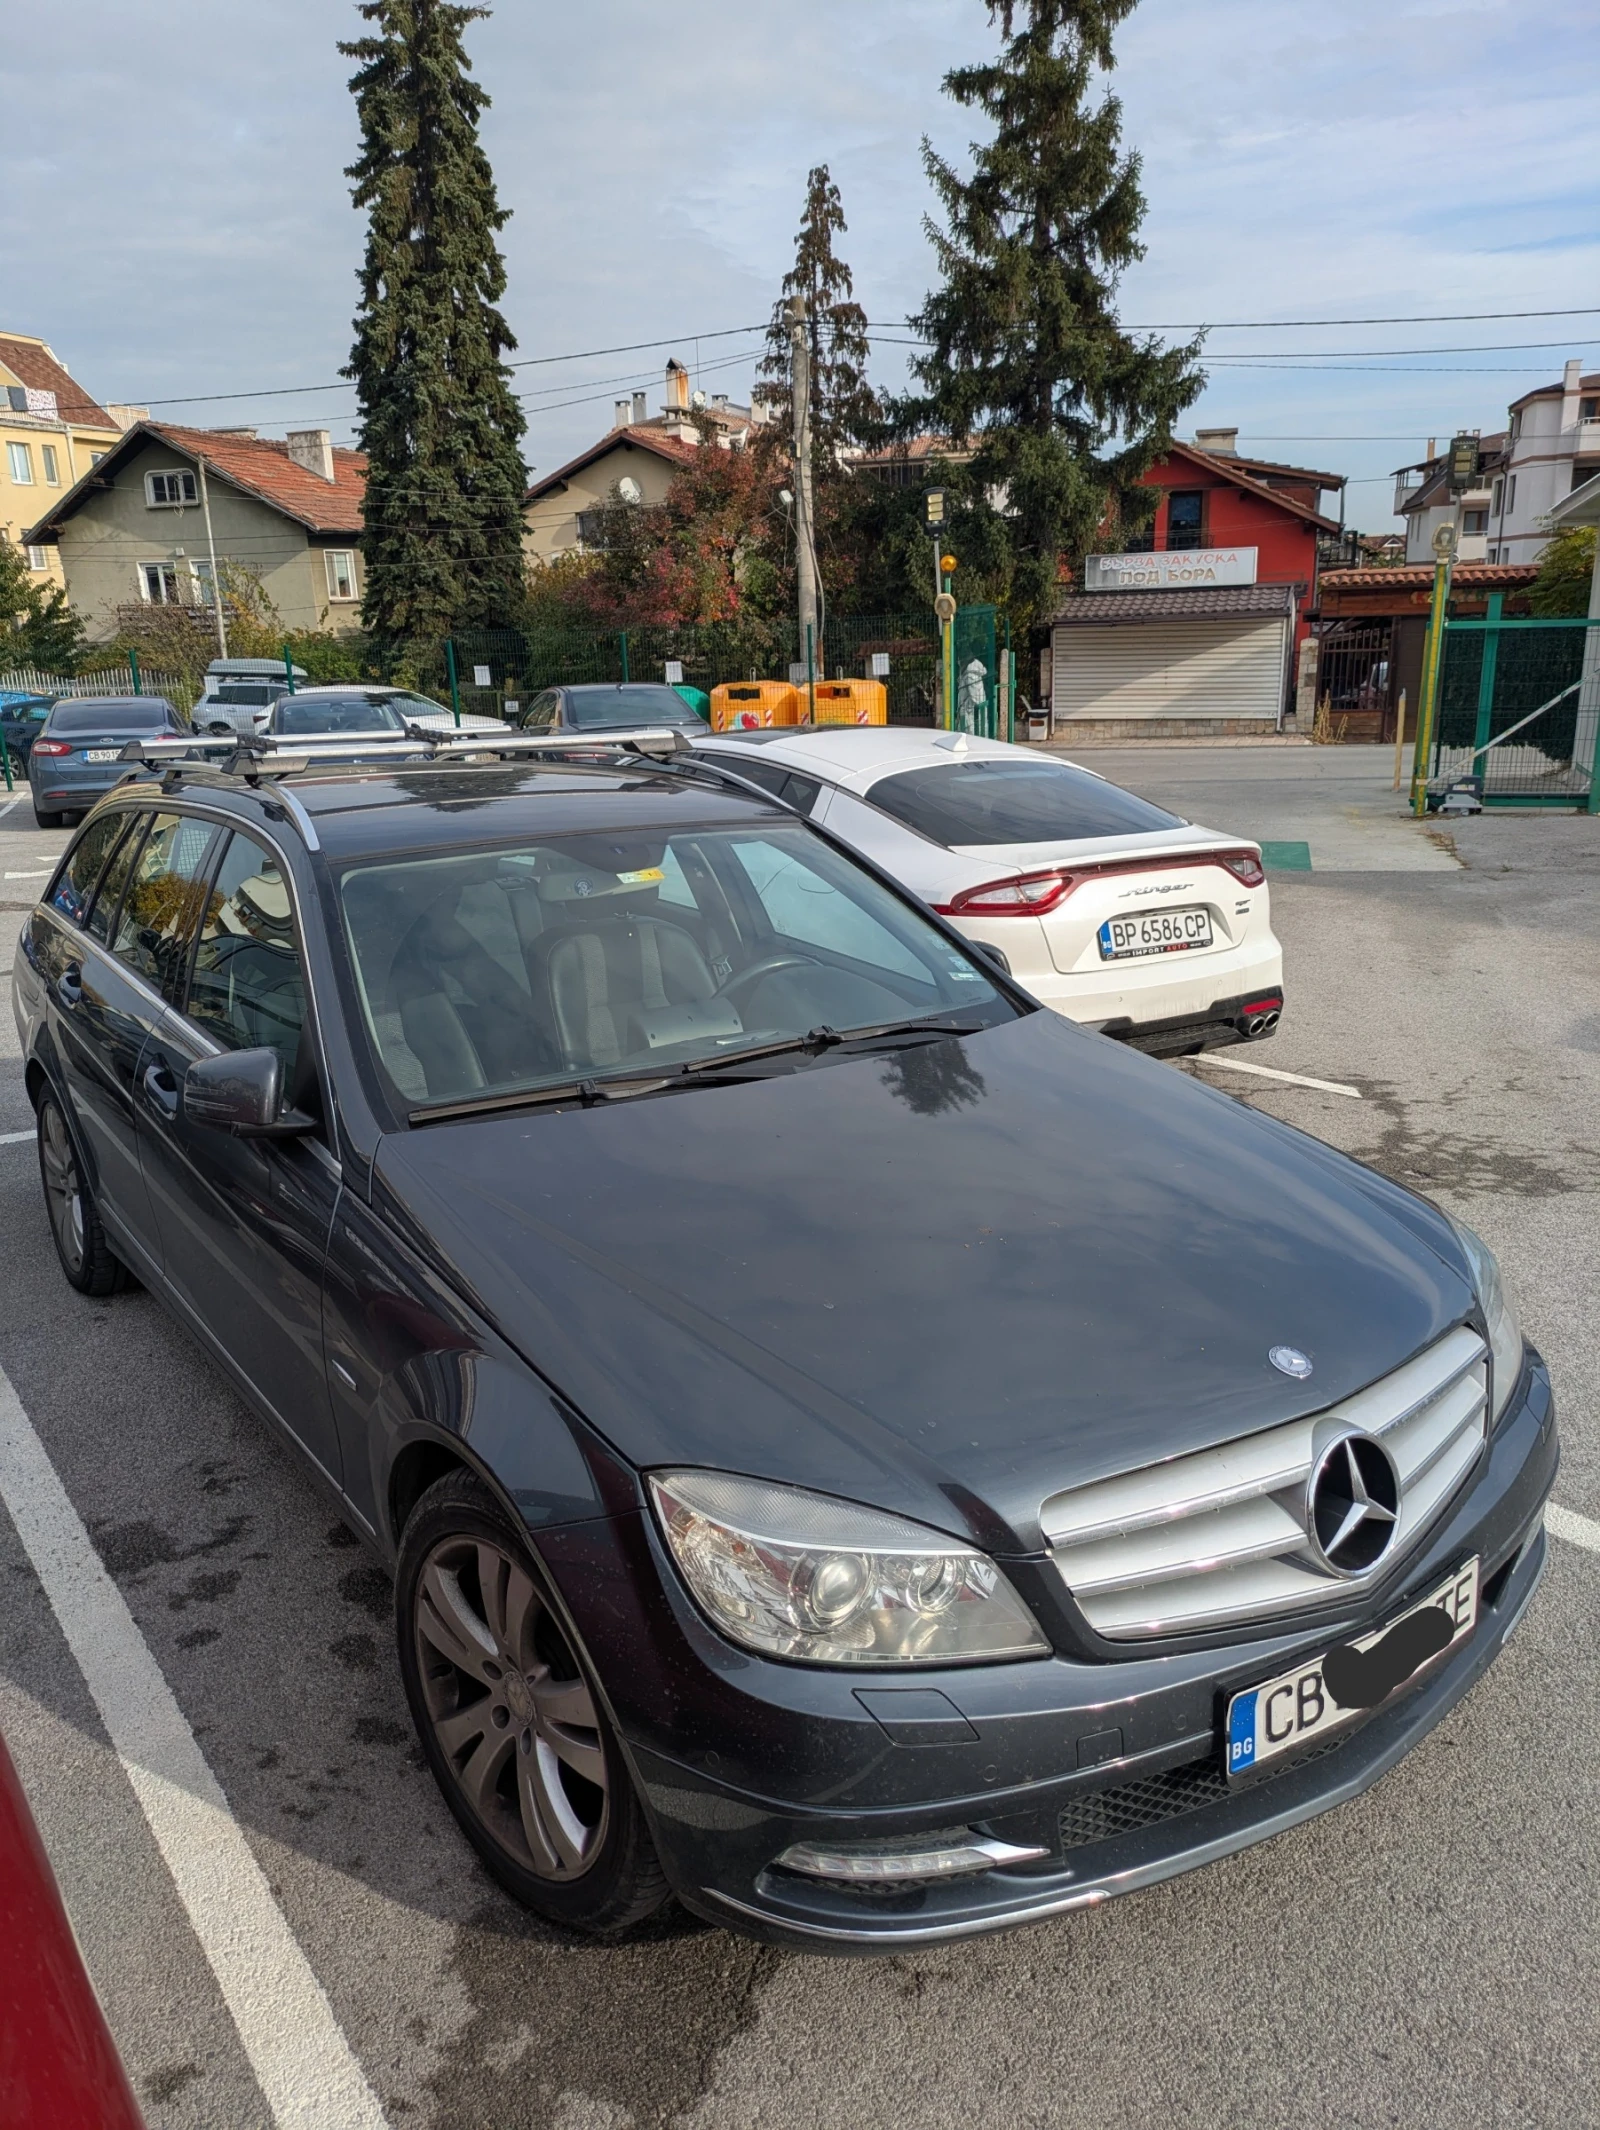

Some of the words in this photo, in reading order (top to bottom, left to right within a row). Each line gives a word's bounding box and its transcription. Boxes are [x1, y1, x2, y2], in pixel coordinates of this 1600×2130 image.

[1101, 556, 1155, 569] БЪРЗА
[1119, 569, 1160, 584] ПОД
[1168, 567, 1216, 582] БОРА
[89, 751, 100, 760] CB
[1112, 922, 1137, 947] BP
[1141, 917, 1183, 944] 6586
[1185, 914, 1206, 938] CP
[1132, 946, 1164, 957] IMPORT
[1167, 943, 1188, 951] AUTO
[1265, 1671, 1325, 1743] CB
[1232, 1737, 1253, 1760] BG
